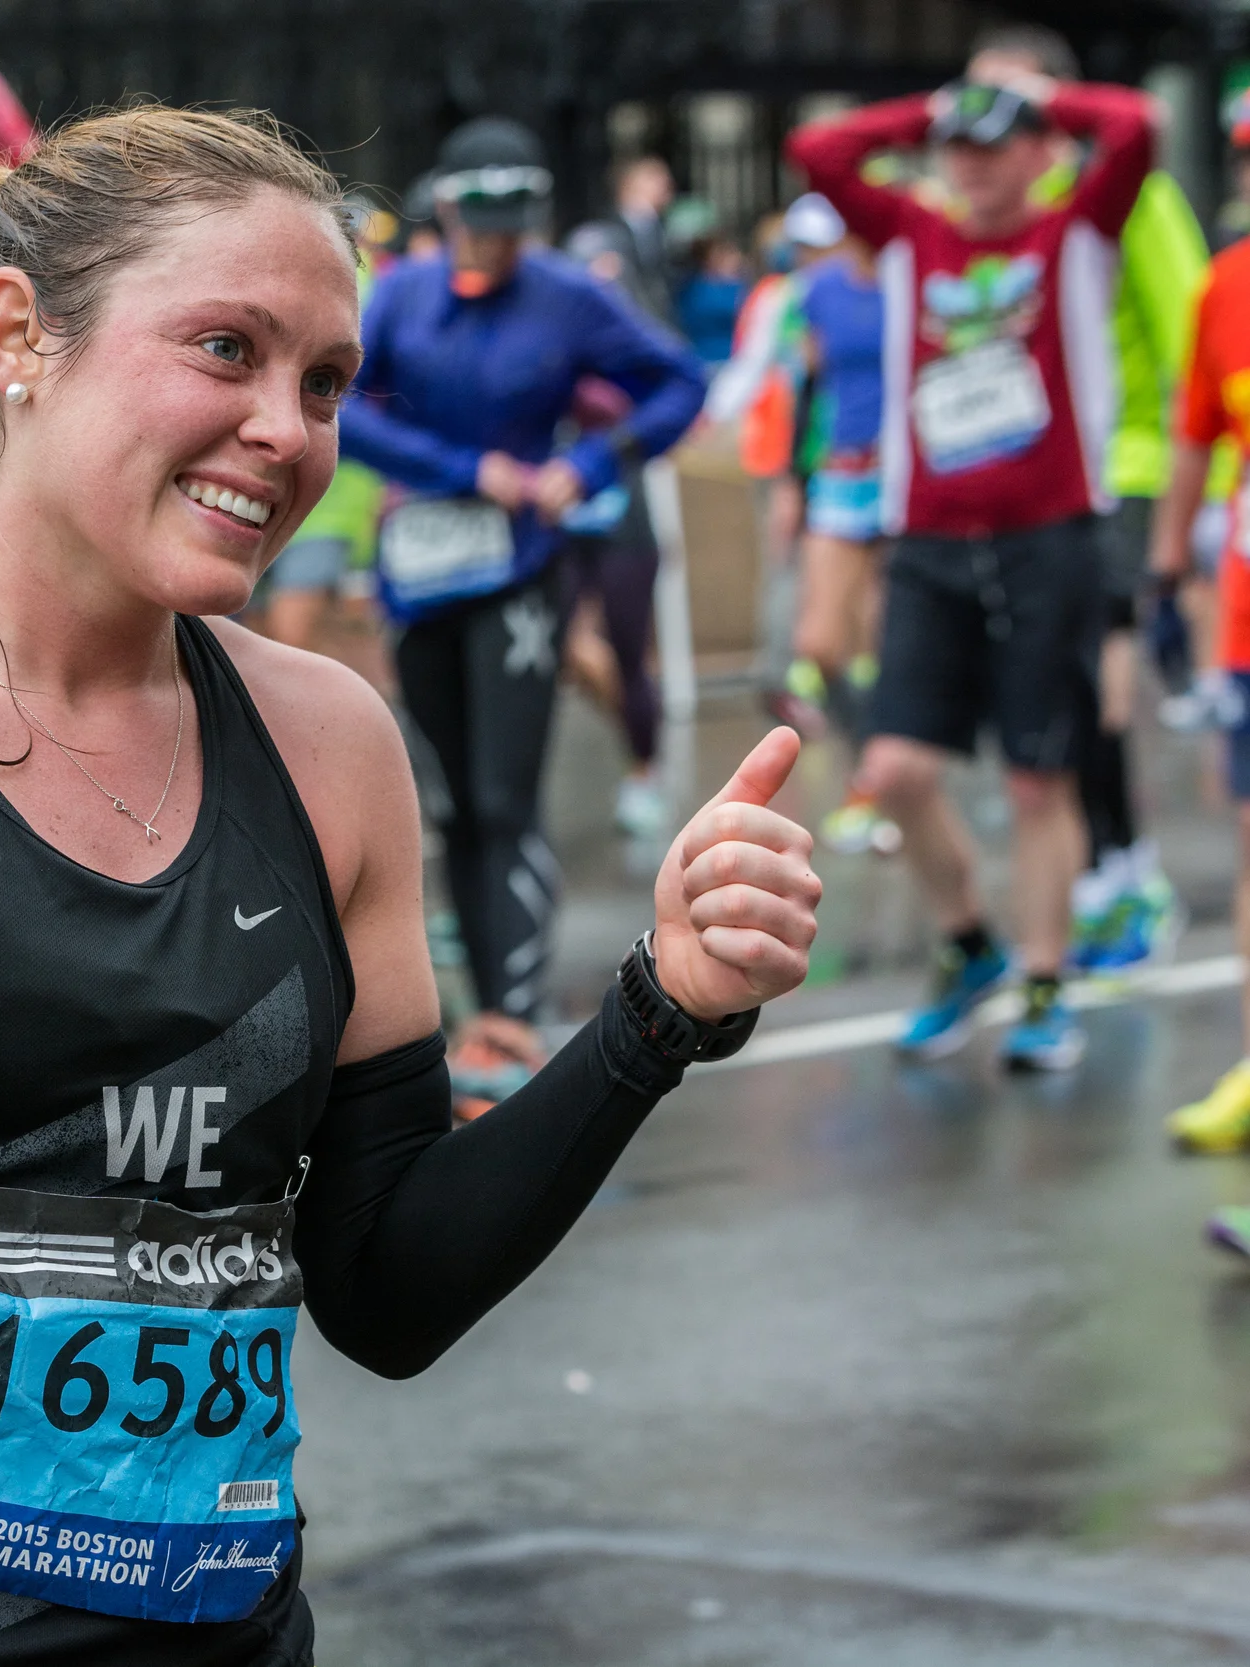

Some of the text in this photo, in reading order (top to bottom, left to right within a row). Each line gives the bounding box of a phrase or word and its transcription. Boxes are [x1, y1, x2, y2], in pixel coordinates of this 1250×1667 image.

[103, 1086, 227, 1188] WE
[56, 1529, 155, 1560] BOSTON
[171, 1539, 280, 1592] John Hancock
